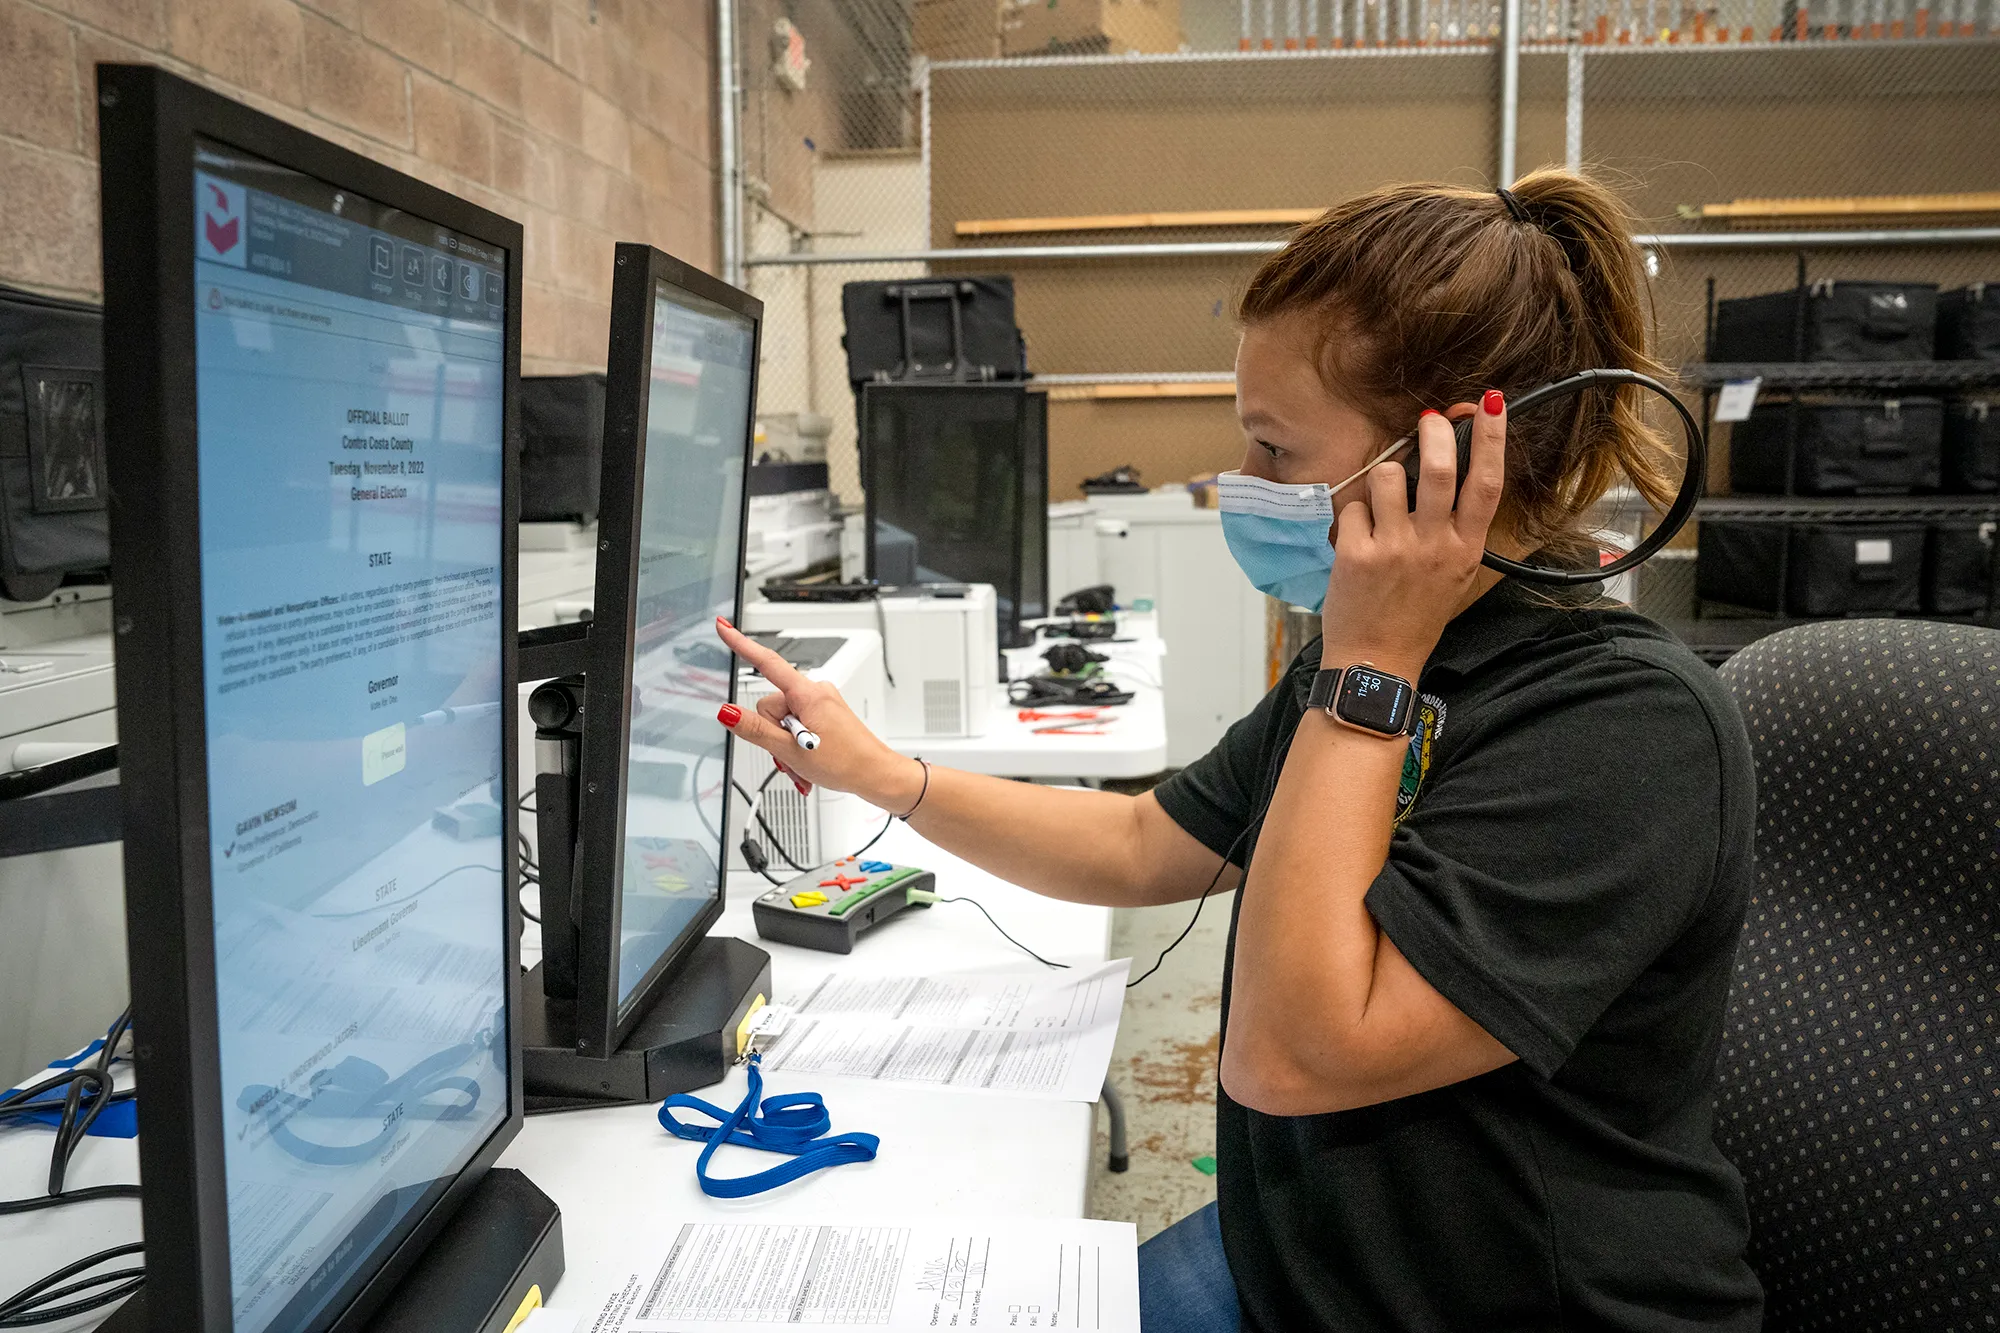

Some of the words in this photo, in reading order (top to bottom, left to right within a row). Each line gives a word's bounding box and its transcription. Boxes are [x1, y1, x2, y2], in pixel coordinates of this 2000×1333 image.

[348, 410, 380, 424] OFFICIAL
[383, 412, 409, 426] BALLOT
[342, 436, 367, 449] Contra
[370, 436, 388, 450] Costa
[391, 436, 413, 454] County
[364, 460, 398, 475] November
[400, 461, 406, 476] 8,
[408, 461, 424, 474] 2022
[351, 486, 379, 500] General
[380, 485, 406, 499] Election
[369, 552, 392, 568] STATE
[368, 676, 398, 694] Governor
[1358, 675, 1371, 697] 11:44
[1370, 678, 1382, 692] 30
[376, 878, 397, 902] STATE
[353, 918, 389, 952] Lieutenant
[390, 900, 418, 926] Governor
[383, 1102, 404, 1132] STATE
[618, 1273, 639, 1303] CHECKLIST
[603, 1292, 620, 1312] DEVICE
[615, 1305, 631, 1326] General
[626, 1284, 642, 1304] Election
[950, 1313, 958, 1326] Date:
